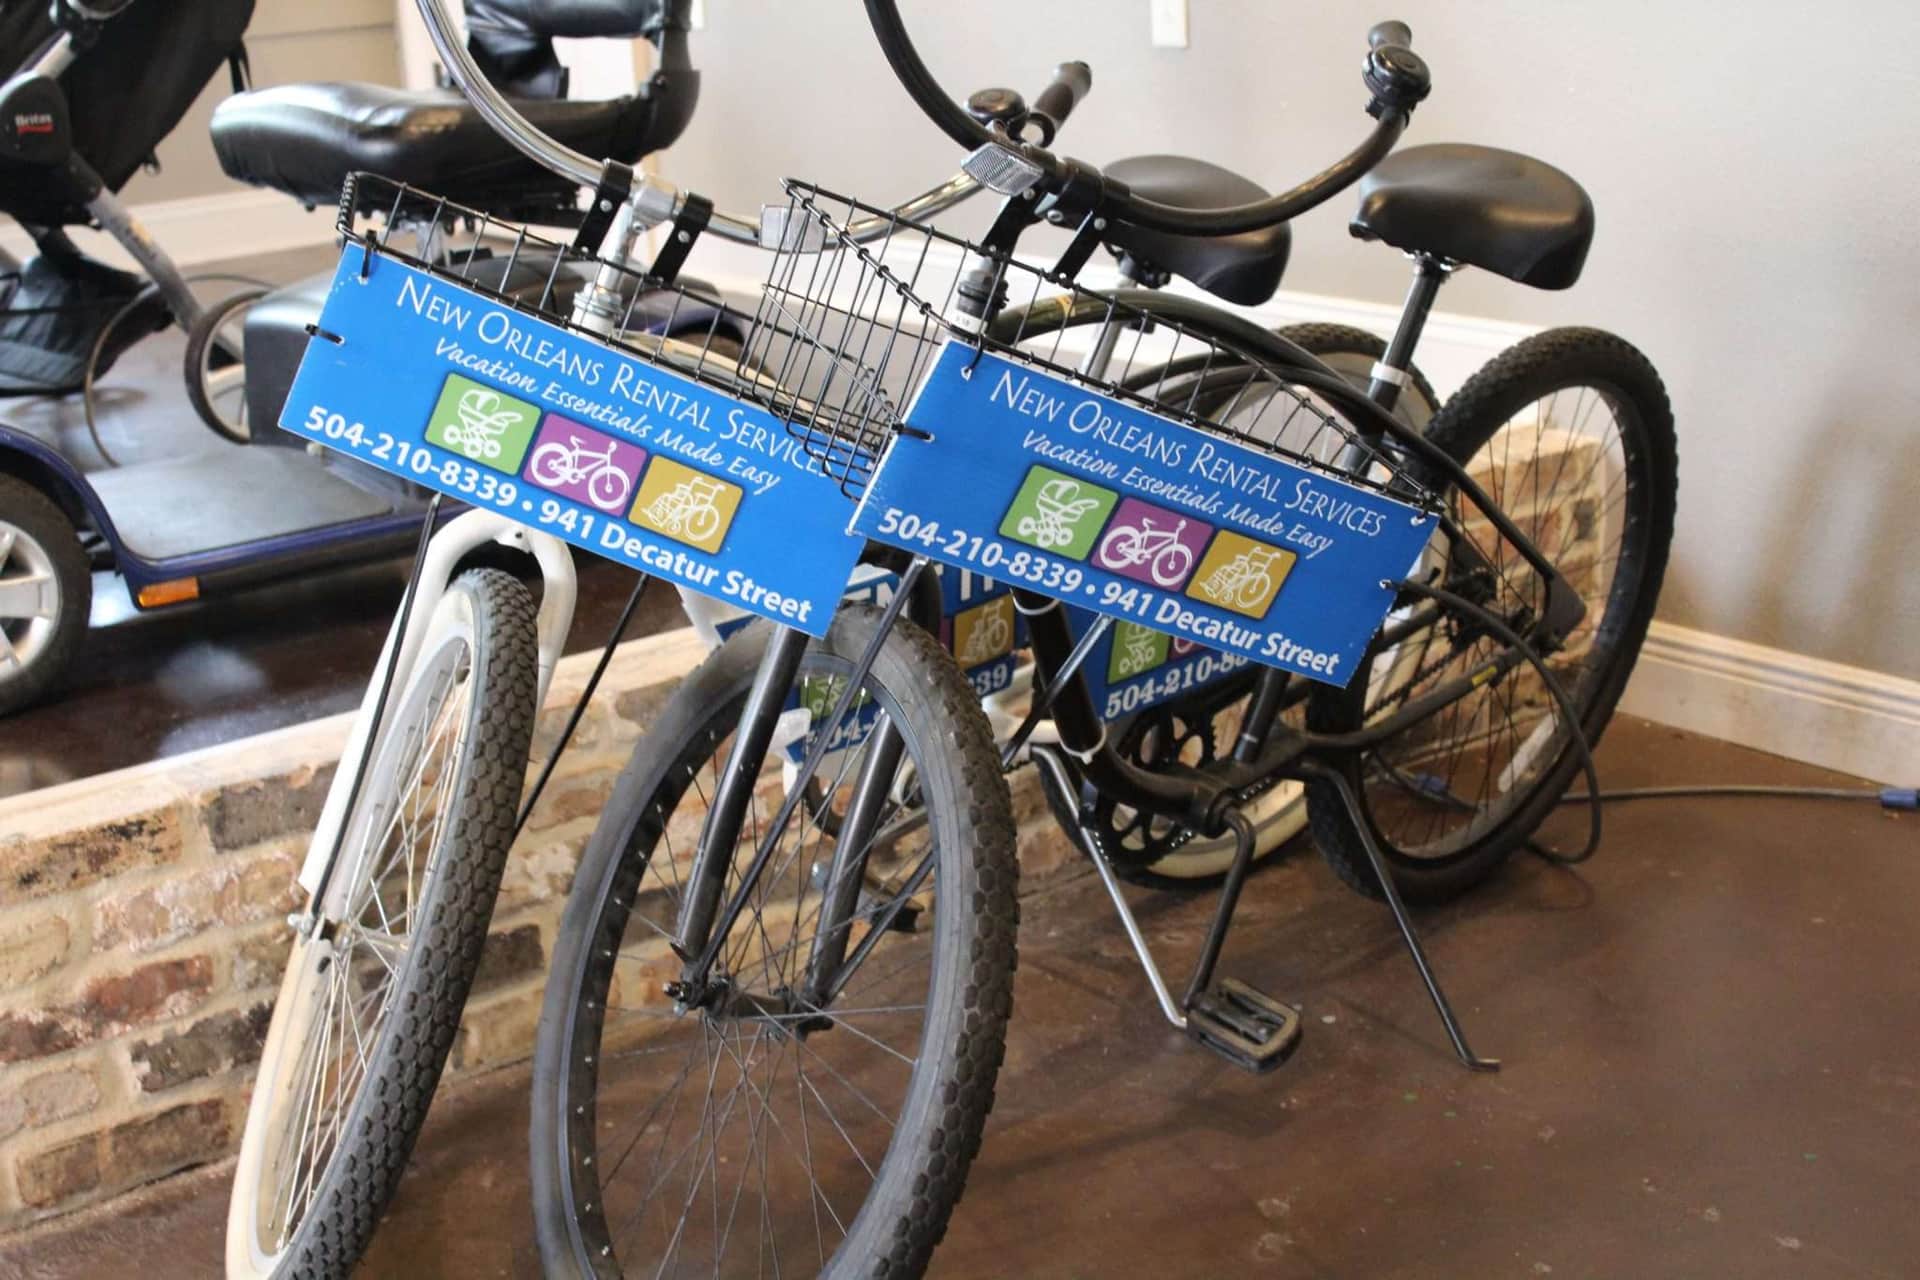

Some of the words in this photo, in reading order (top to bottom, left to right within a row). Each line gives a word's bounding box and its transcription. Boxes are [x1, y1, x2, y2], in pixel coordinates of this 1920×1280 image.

[396, 275, 471, 331] NEW
[478, 311, 604, 386] ORLEANS
[609, 362, 711, 432] RENTAL
[435, 337, 538, 393] Vacation
[541, 382, 654, 438] Essentials
[655, 429, 724, 466] Made
[728, 456, 781, 495] Easy
[304, 406, 517, 507] 504-210-8339
[539, 500, 595, 539] 941
[600, 521, 719, 586] Decatur
[721, 570, 812, 623] Street
[990, 369, 1065, 422] NEW
[1069, 400, 1187, 467] ORLEANS
[1188, 442, 1281, 503] RENTAL
[1284, 478, 1387, 537] SERVICES
[1023, 429, 1120, 480] Vacation
[1121, 466, 1223, 515] Essentials
[1223, 503, 1285, 536] Made
[1286, 524, 1334, 560] Easy
[878, 508, 1083, 595] 504-210-8339
[1103, 581, 1153, 617] 941
[1155, 599, 1261, 649] Decatur
[1261, 633, 1340, 676] Street
